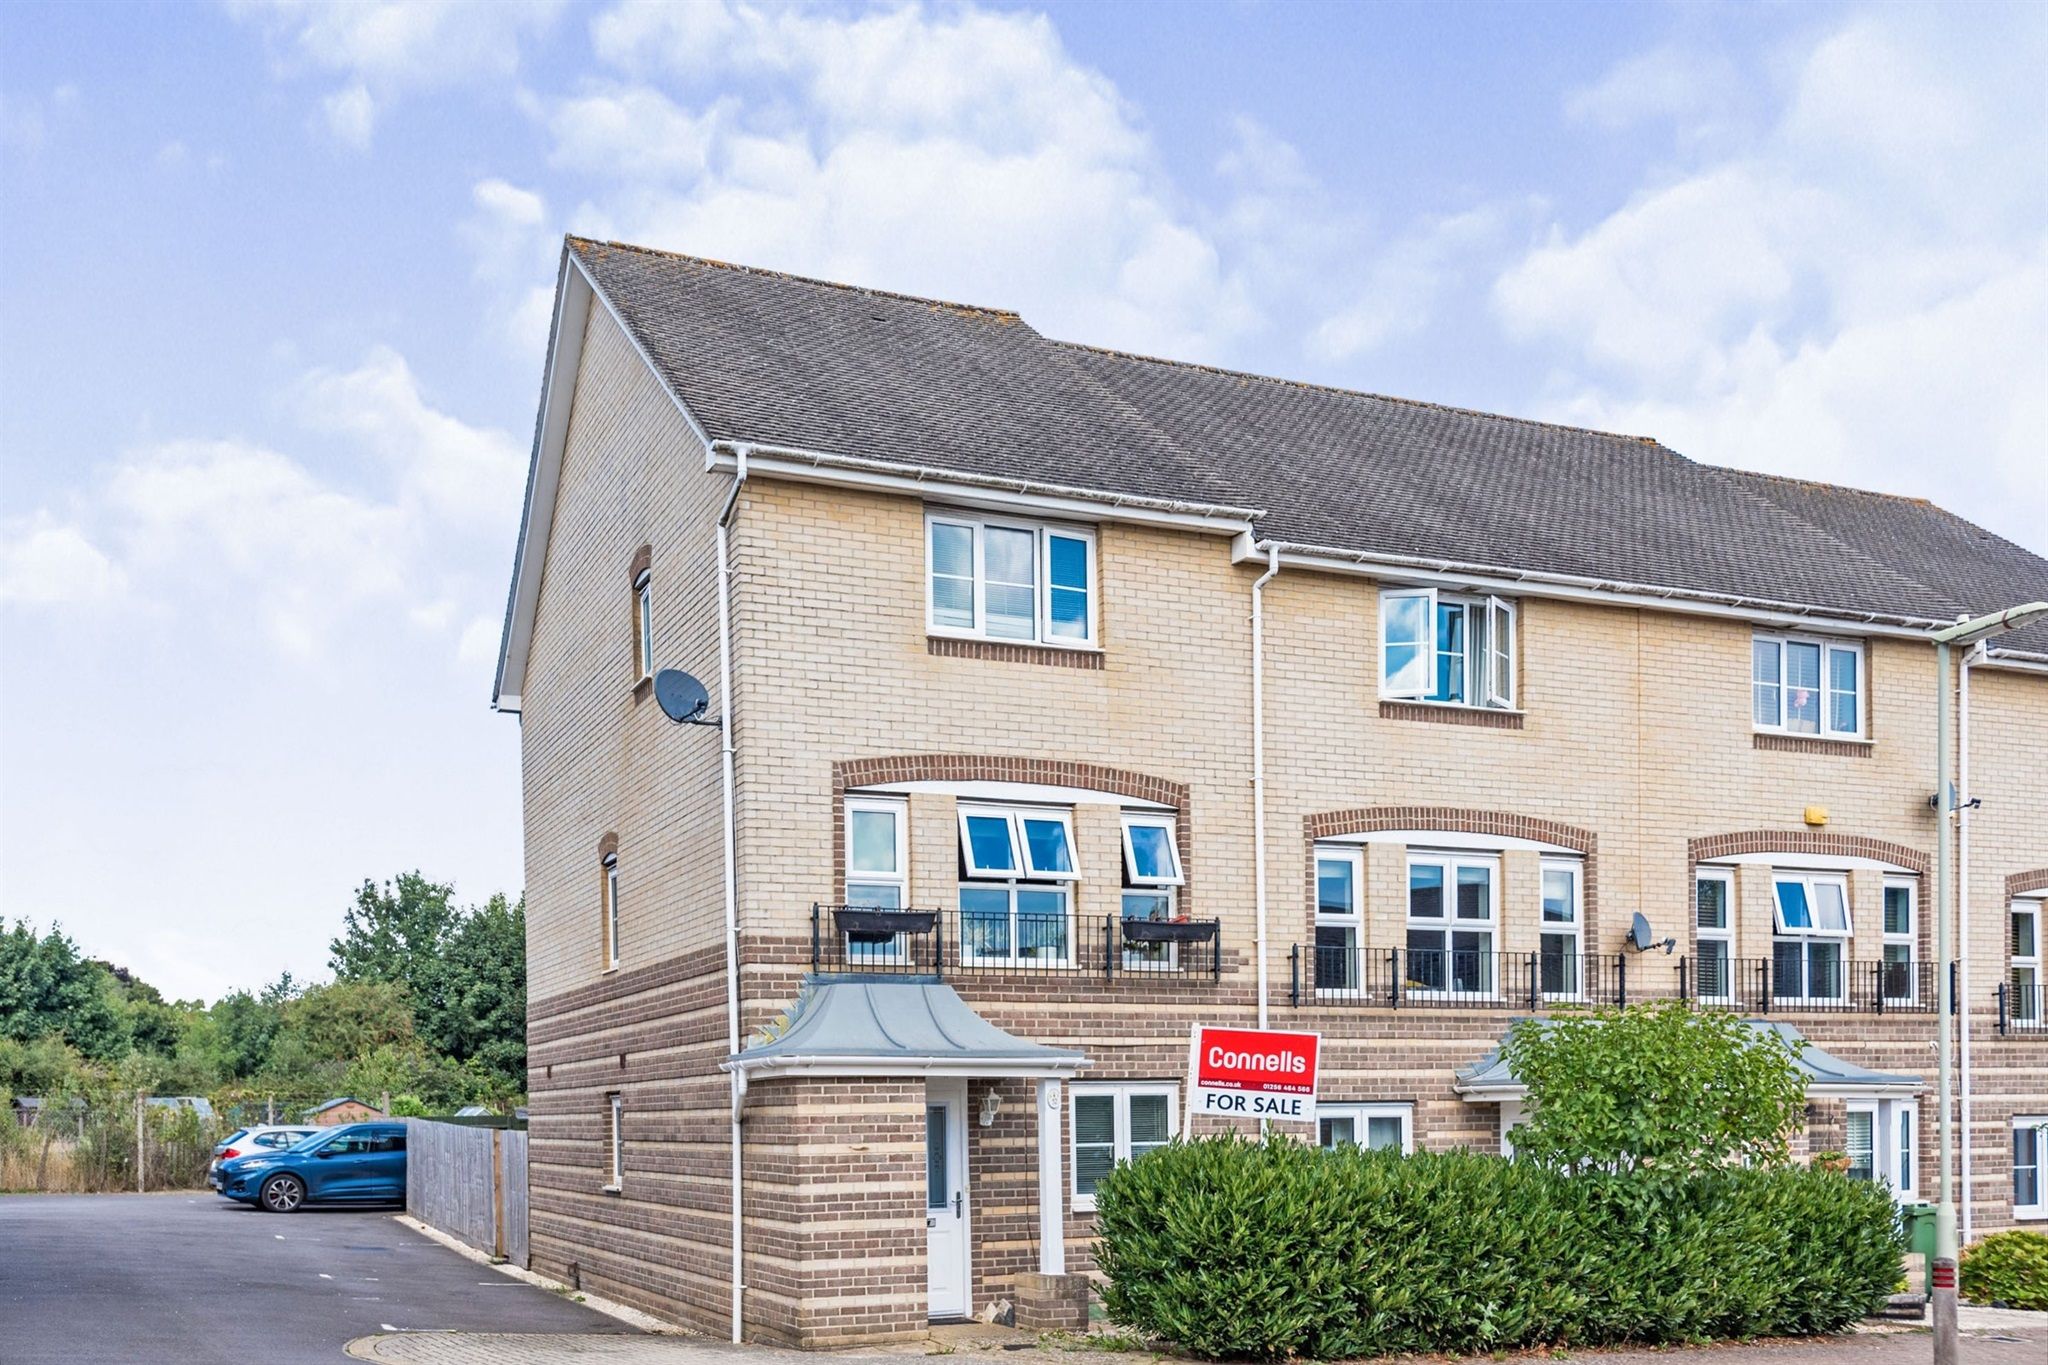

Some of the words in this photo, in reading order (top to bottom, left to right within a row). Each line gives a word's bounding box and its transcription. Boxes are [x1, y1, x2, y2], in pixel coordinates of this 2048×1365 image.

[1208, 1046, 1306, 1073] Connells
[1200, 1079, 1242, 1088] connells.co.uk
[1206, 1093, 1246, 1112] FOR
[1253, 1097, 1302, 1115] SALE
